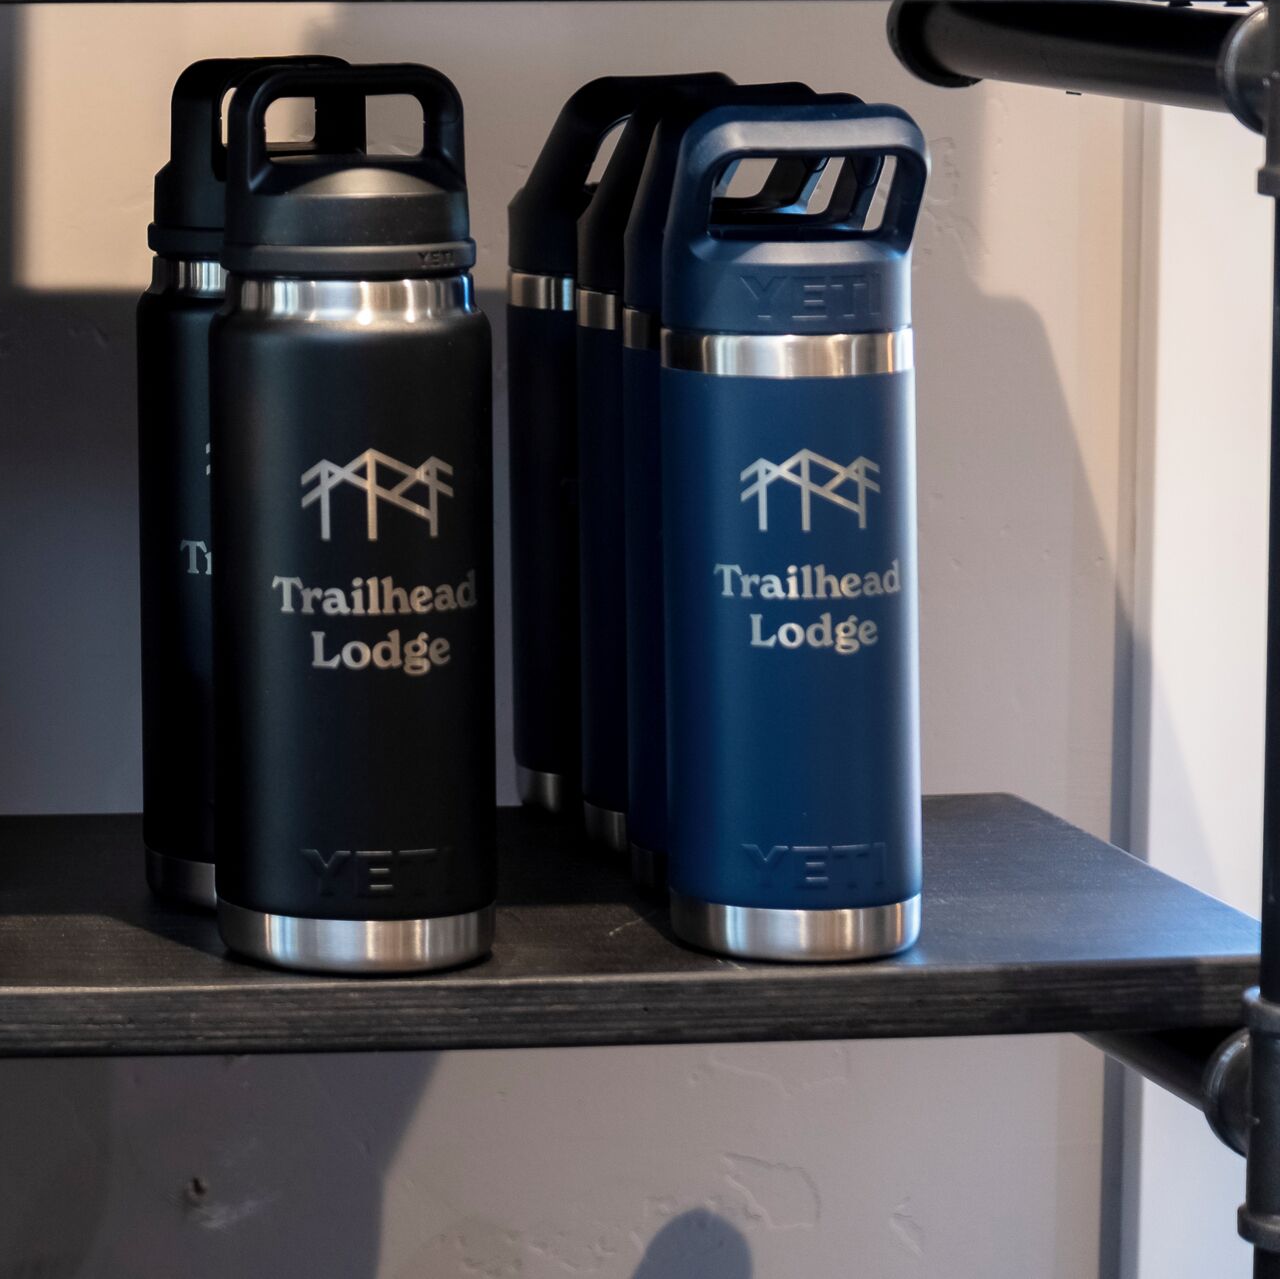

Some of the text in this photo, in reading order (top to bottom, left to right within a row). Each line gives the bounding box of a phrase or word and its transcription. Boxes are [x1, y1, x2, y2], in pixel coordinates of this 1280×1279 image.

[272, 570, 478, 615] Trailhead
[714, 560, 901, 600] Trailhead
[311, 630, 451, 676] Lodge
[750, 612, 878, 655] Lodge
